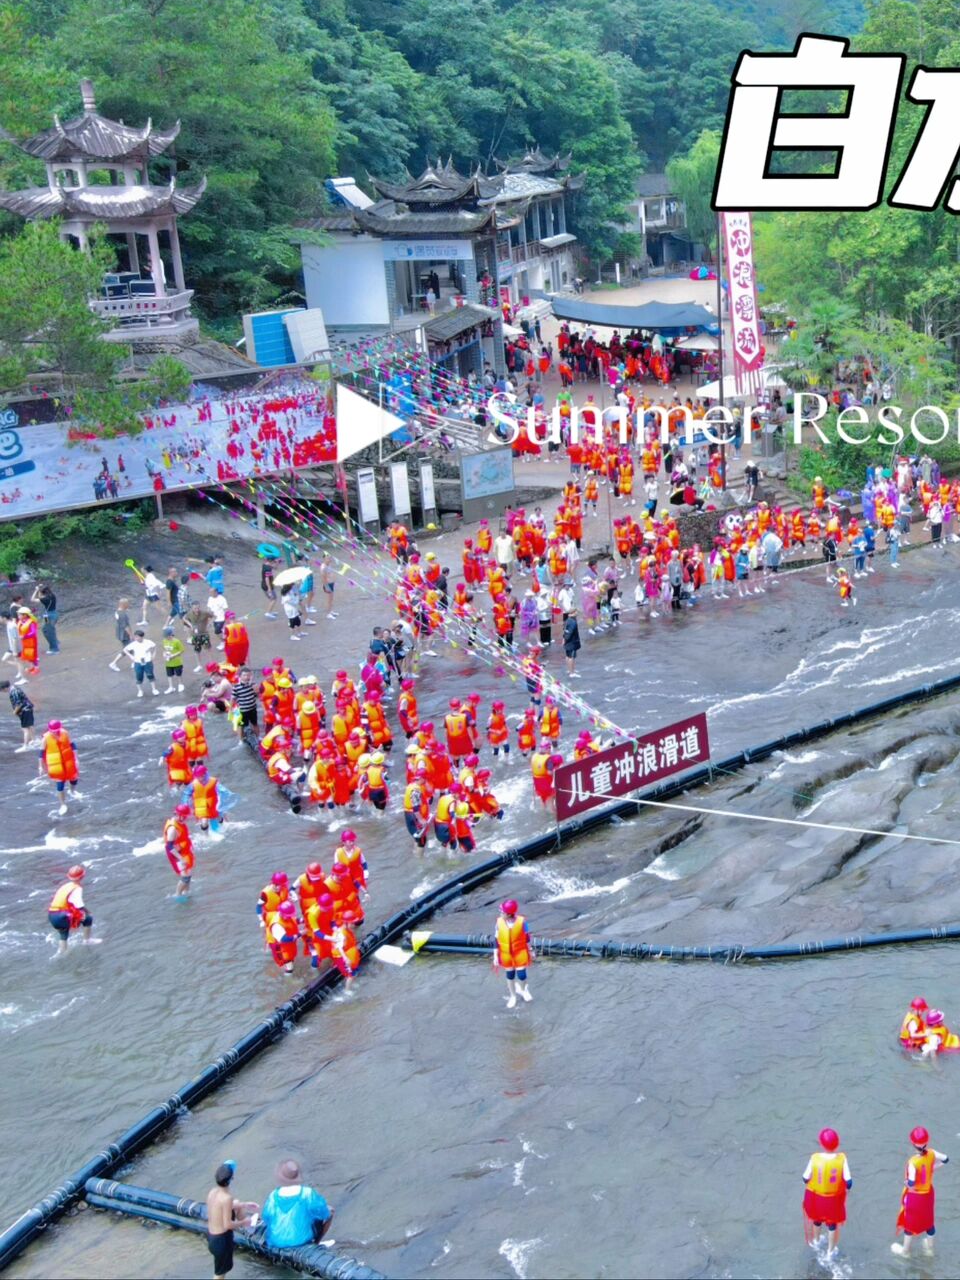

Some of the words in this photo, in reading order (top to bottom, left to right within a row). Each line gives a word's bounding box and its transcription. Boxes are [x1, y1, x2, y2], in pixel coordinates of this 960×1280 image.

[567, 725, 701, 808] 儿童冲浪滑道
